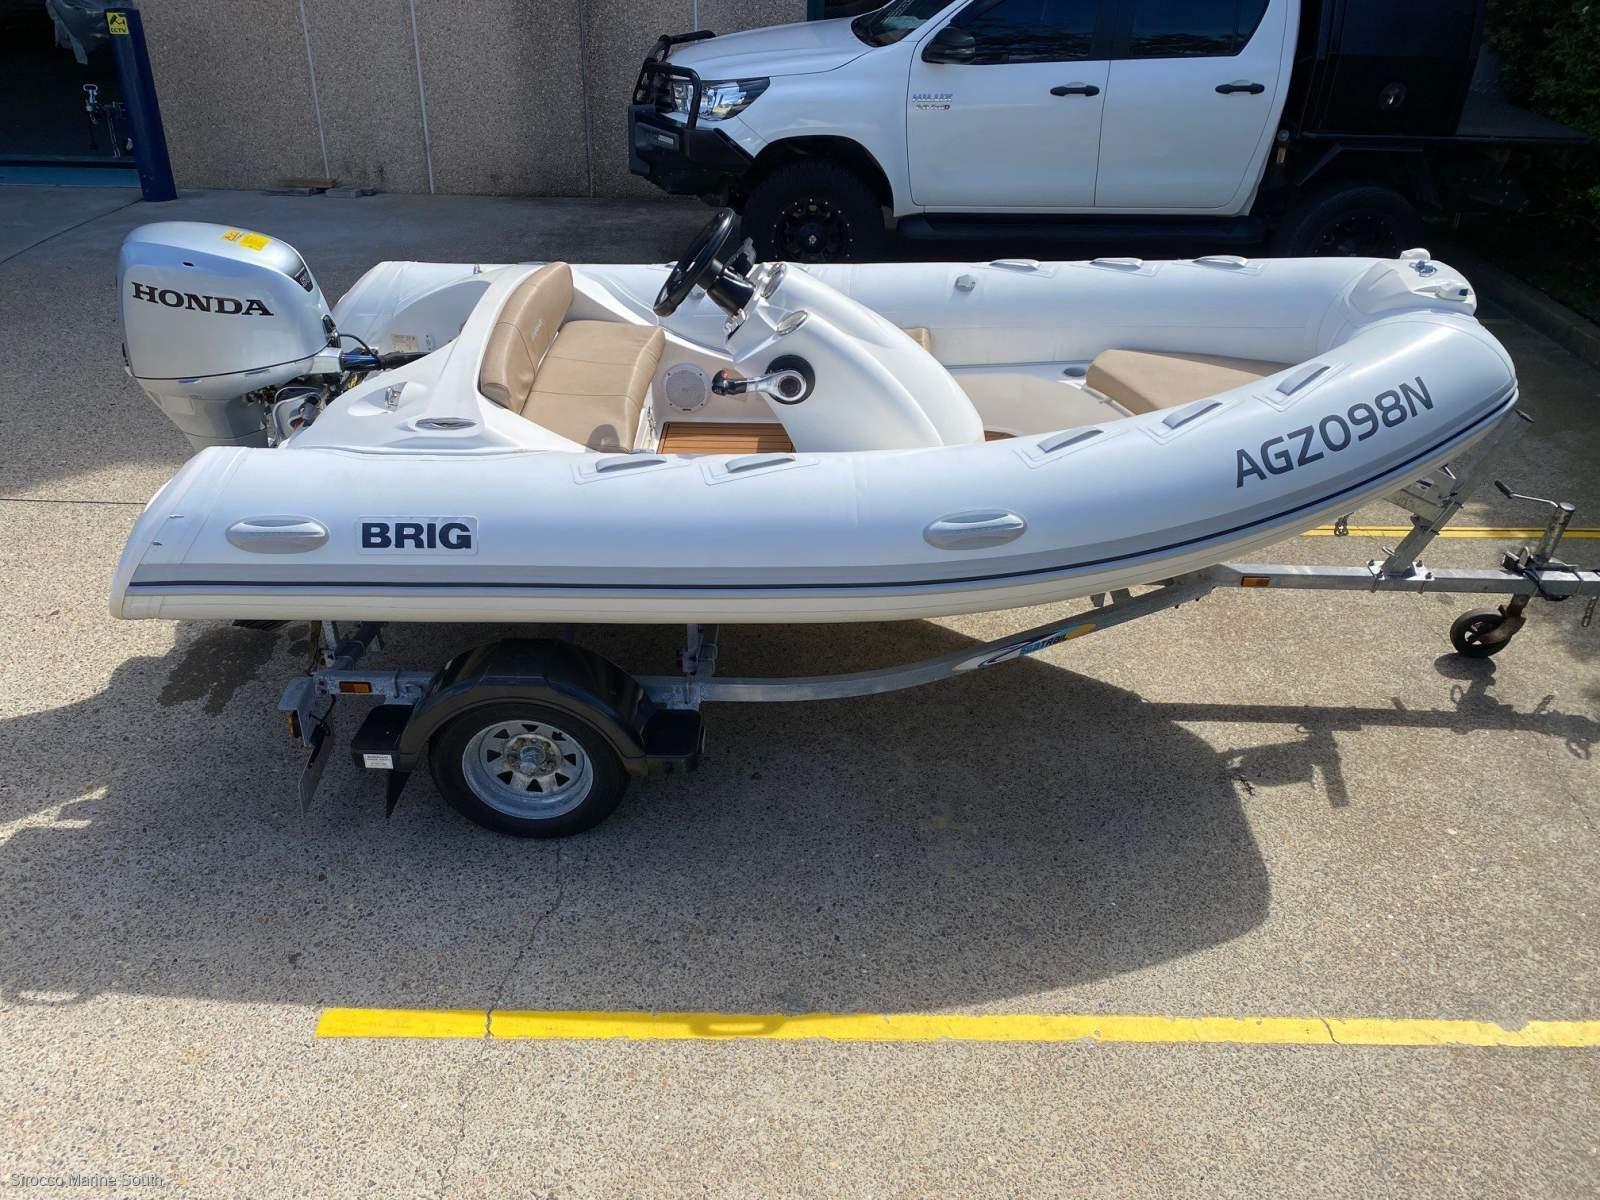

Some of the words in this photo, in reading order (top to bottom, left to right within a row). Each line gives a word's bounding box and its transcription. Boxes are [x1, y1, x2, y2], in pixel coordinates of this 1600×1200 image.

[131, 281, 275, 316] HONDA
[1236, 376, 1434, 488] AGZ098N
[361, 522, 472, 550] BRIG
